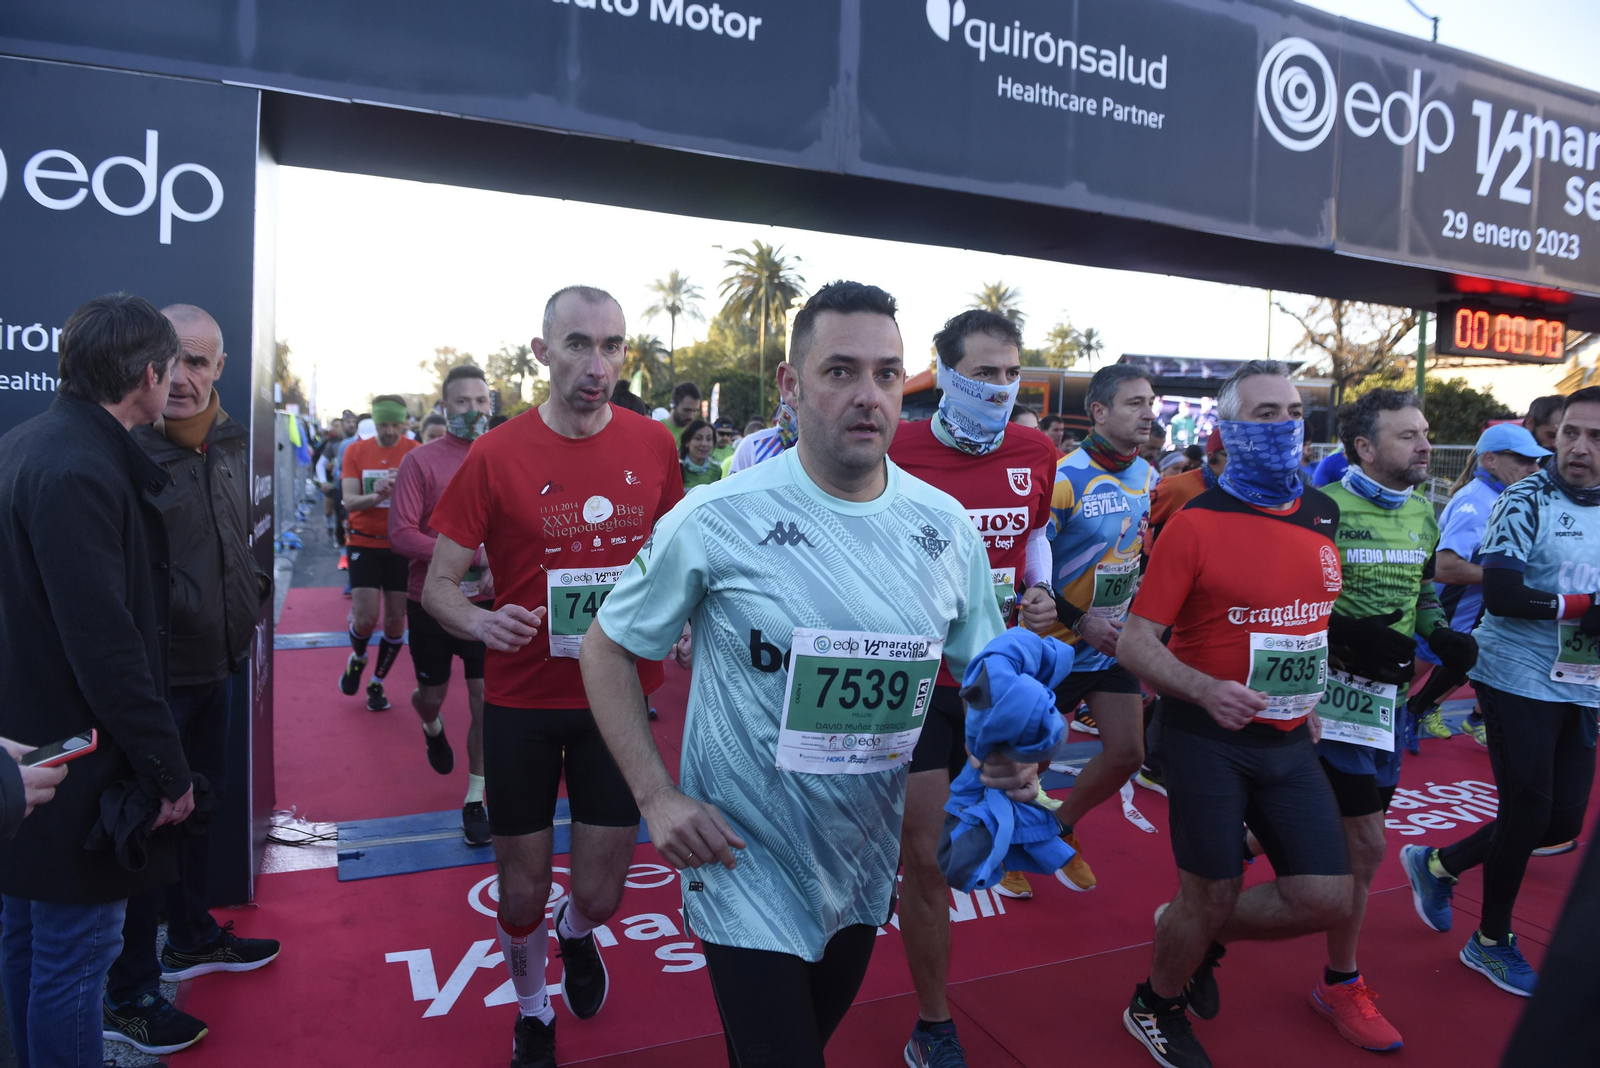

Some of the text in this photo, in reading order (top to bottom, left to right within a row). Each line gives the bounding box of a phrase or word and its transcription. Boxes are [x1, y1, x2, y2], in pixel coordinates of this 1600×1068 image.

[650, 0, 762, 41] Motor
[964, 18, 1167, 90] quirónsalud
[998, 75, 1165, 129] Healthcare Partner
[1344, 68, 1455, 173] edp
[23, 128, 224, 245] edp
[1441, 209, 1580, 260] 29 enero 2023
[951, 380, 982, 400] SEVILLA
[540, 502, 579, 514] 11.11.2014
[542, 503, 645, 528] XXVI Bieg
[1083, 496, 1131, 518] SEVILLA
[995, 536, 1014, 550] best
[1339, 530, 1373, 540] HOKA
[1346, 548, 1383, 563] MEDIO
[574, 573, 593, 584] edp
[750, 629, 792, 674] b
[833, 637, 860, 654] edp
[879, 639, 924, 651] maratón
[889, 648, 923, 658] sevilla
[1276, 638, 1294, 649] edp
[1265, 655, 1317, 683] 7635
[816, 667, 909, 711] 7539
[815, 722, 907, 731] DAVID Muñoz TORRICO
[858, 734, 881, 749] edp
